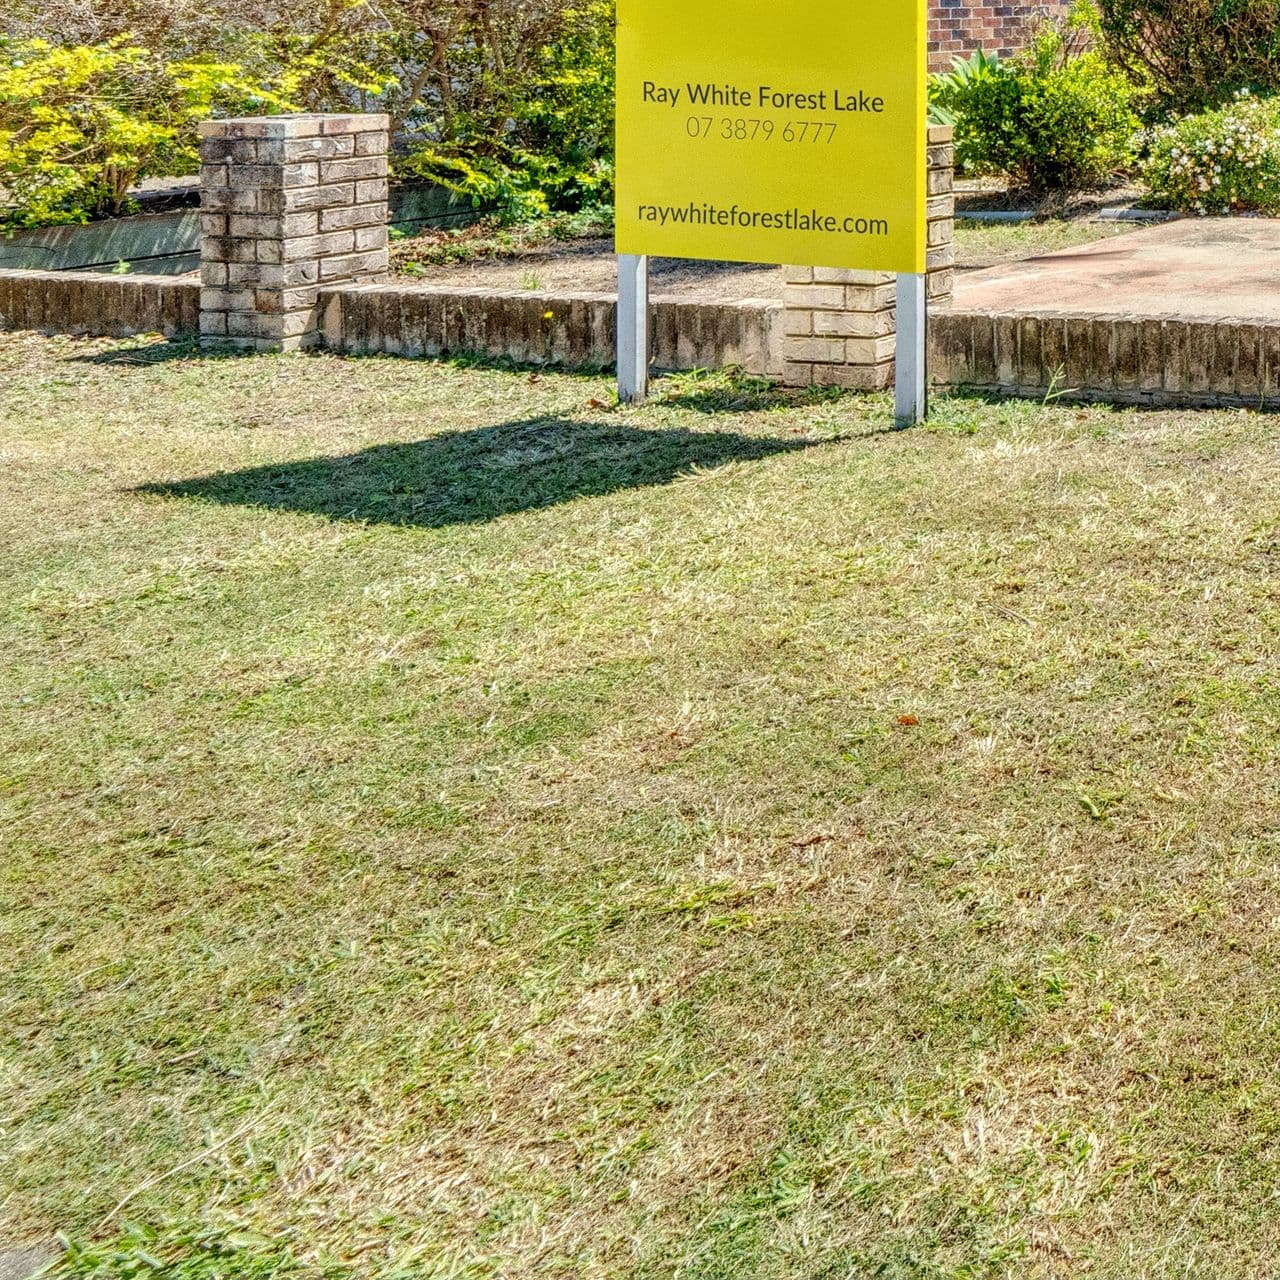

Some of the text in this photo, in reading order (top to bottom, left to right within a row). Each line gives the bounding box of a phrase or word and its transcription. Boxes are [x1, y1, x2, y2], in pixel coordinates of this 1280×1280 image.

[643, 81, 885, 113] Ray White Forest Lake
[686, 116, 838, 144] 07 3879 6777
[638, 201, 888, 236] raywhiteforestlake.com
